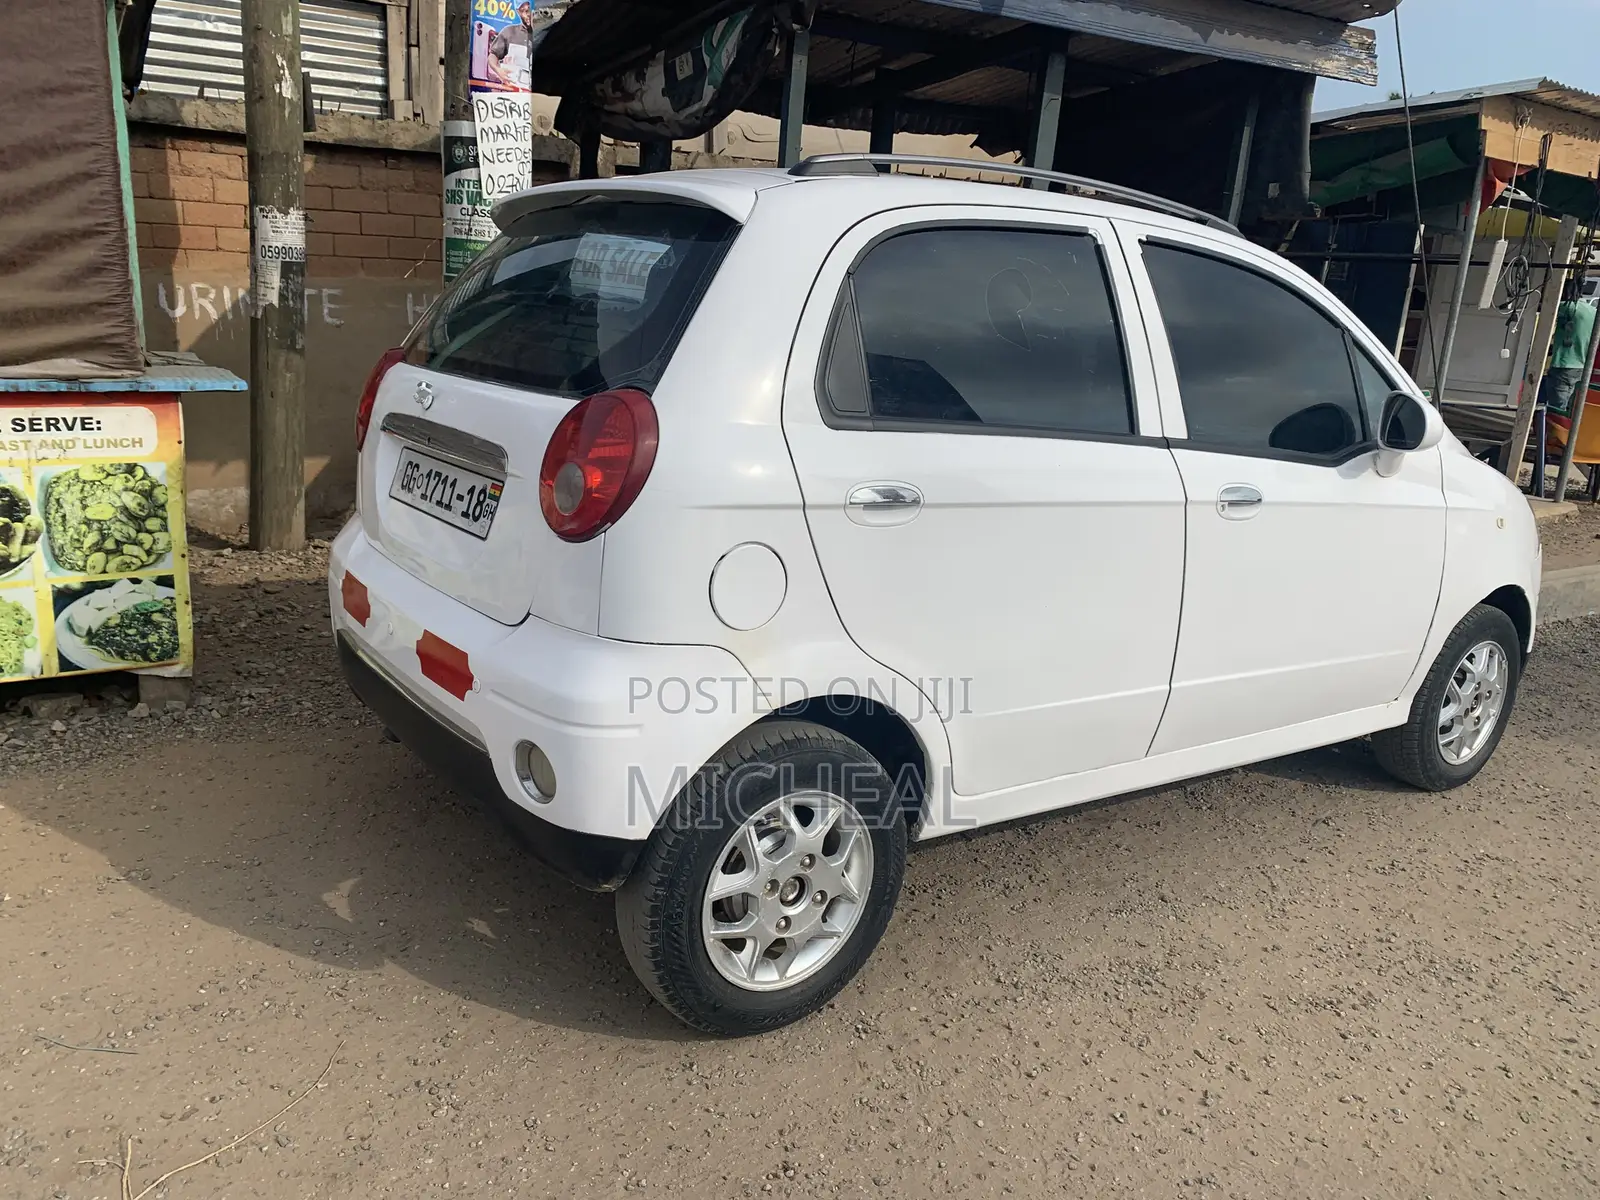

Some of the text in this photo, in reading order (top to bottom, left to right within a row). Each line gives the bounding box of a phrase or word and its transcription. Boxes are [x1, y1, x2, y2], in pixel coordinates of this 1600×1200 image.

[10, 416, 102, 432] SERVE:
[37, 438, 77, 450] AND
[82, 437, 144, 450] LUNCH
